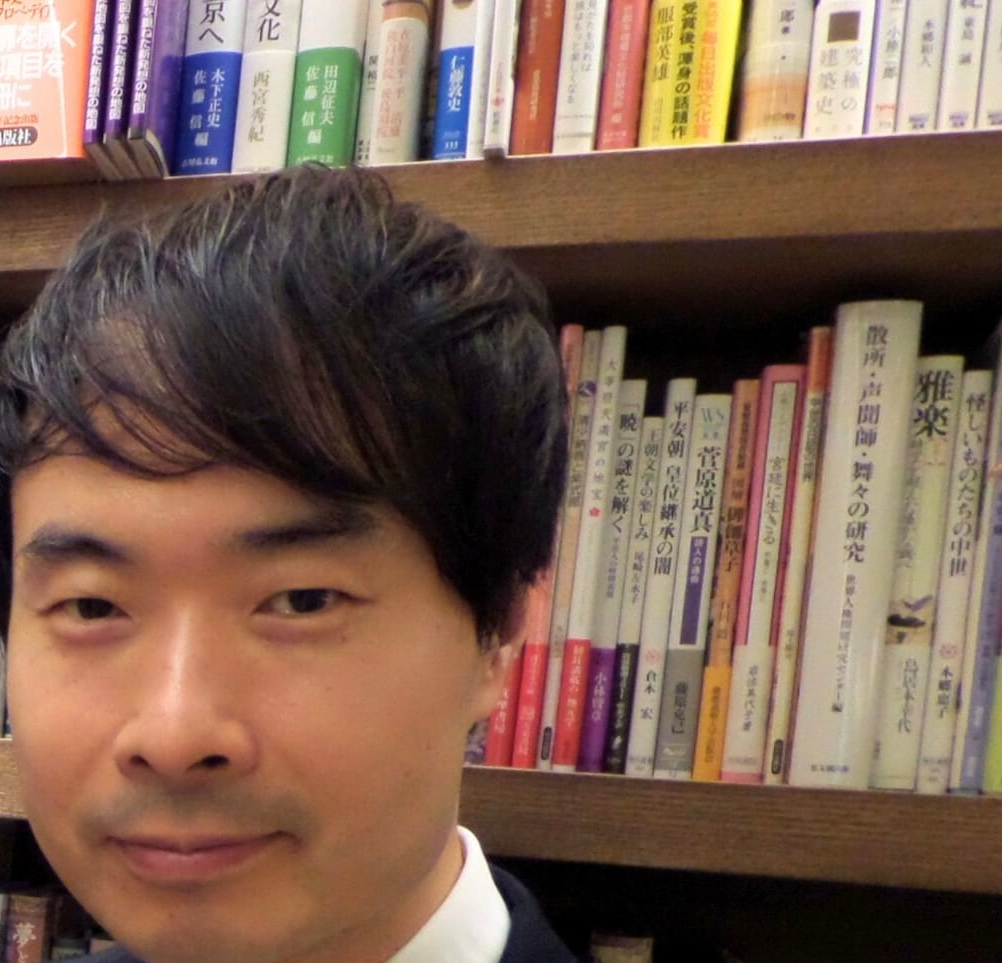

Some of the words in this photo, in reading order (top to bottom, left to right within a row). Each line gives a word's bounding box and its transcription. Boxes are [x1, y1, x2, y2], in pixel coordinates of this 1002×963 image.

[653, 6, 675, 82] 服部英雄
[672, 2, 697, 140] 受賞後、渾身の話題作
[817, 48, 840, 115] 建築史
[840, 47, 864, 111] 究極の
[207, 68, 226, 128] 木下正史
[248, 71, 270, 142] 西宮秀紀
[319, 65, 339, 125] 田辺征夫
[447, 55, 466, 112] 仁藤敦史
[666, 400, 692, 459] 平安朝
[913, 370, 955, 438] 雅楽
[612, 403, 640, 535] 「暁」の謎を解く
[844, 323, 889, 563] 散所・声聞師・舞々の研究
[634, 429, 660, 541] 王朝文学の楽しみ
[653, 465, 688, 576] 皇位継承の闇
[690, 445, 722, 535] 菅原道真
[762, 456, 786, 545] 宮廷に生きる
[949, 393, 987, 578] 怪しいものたちの中世
